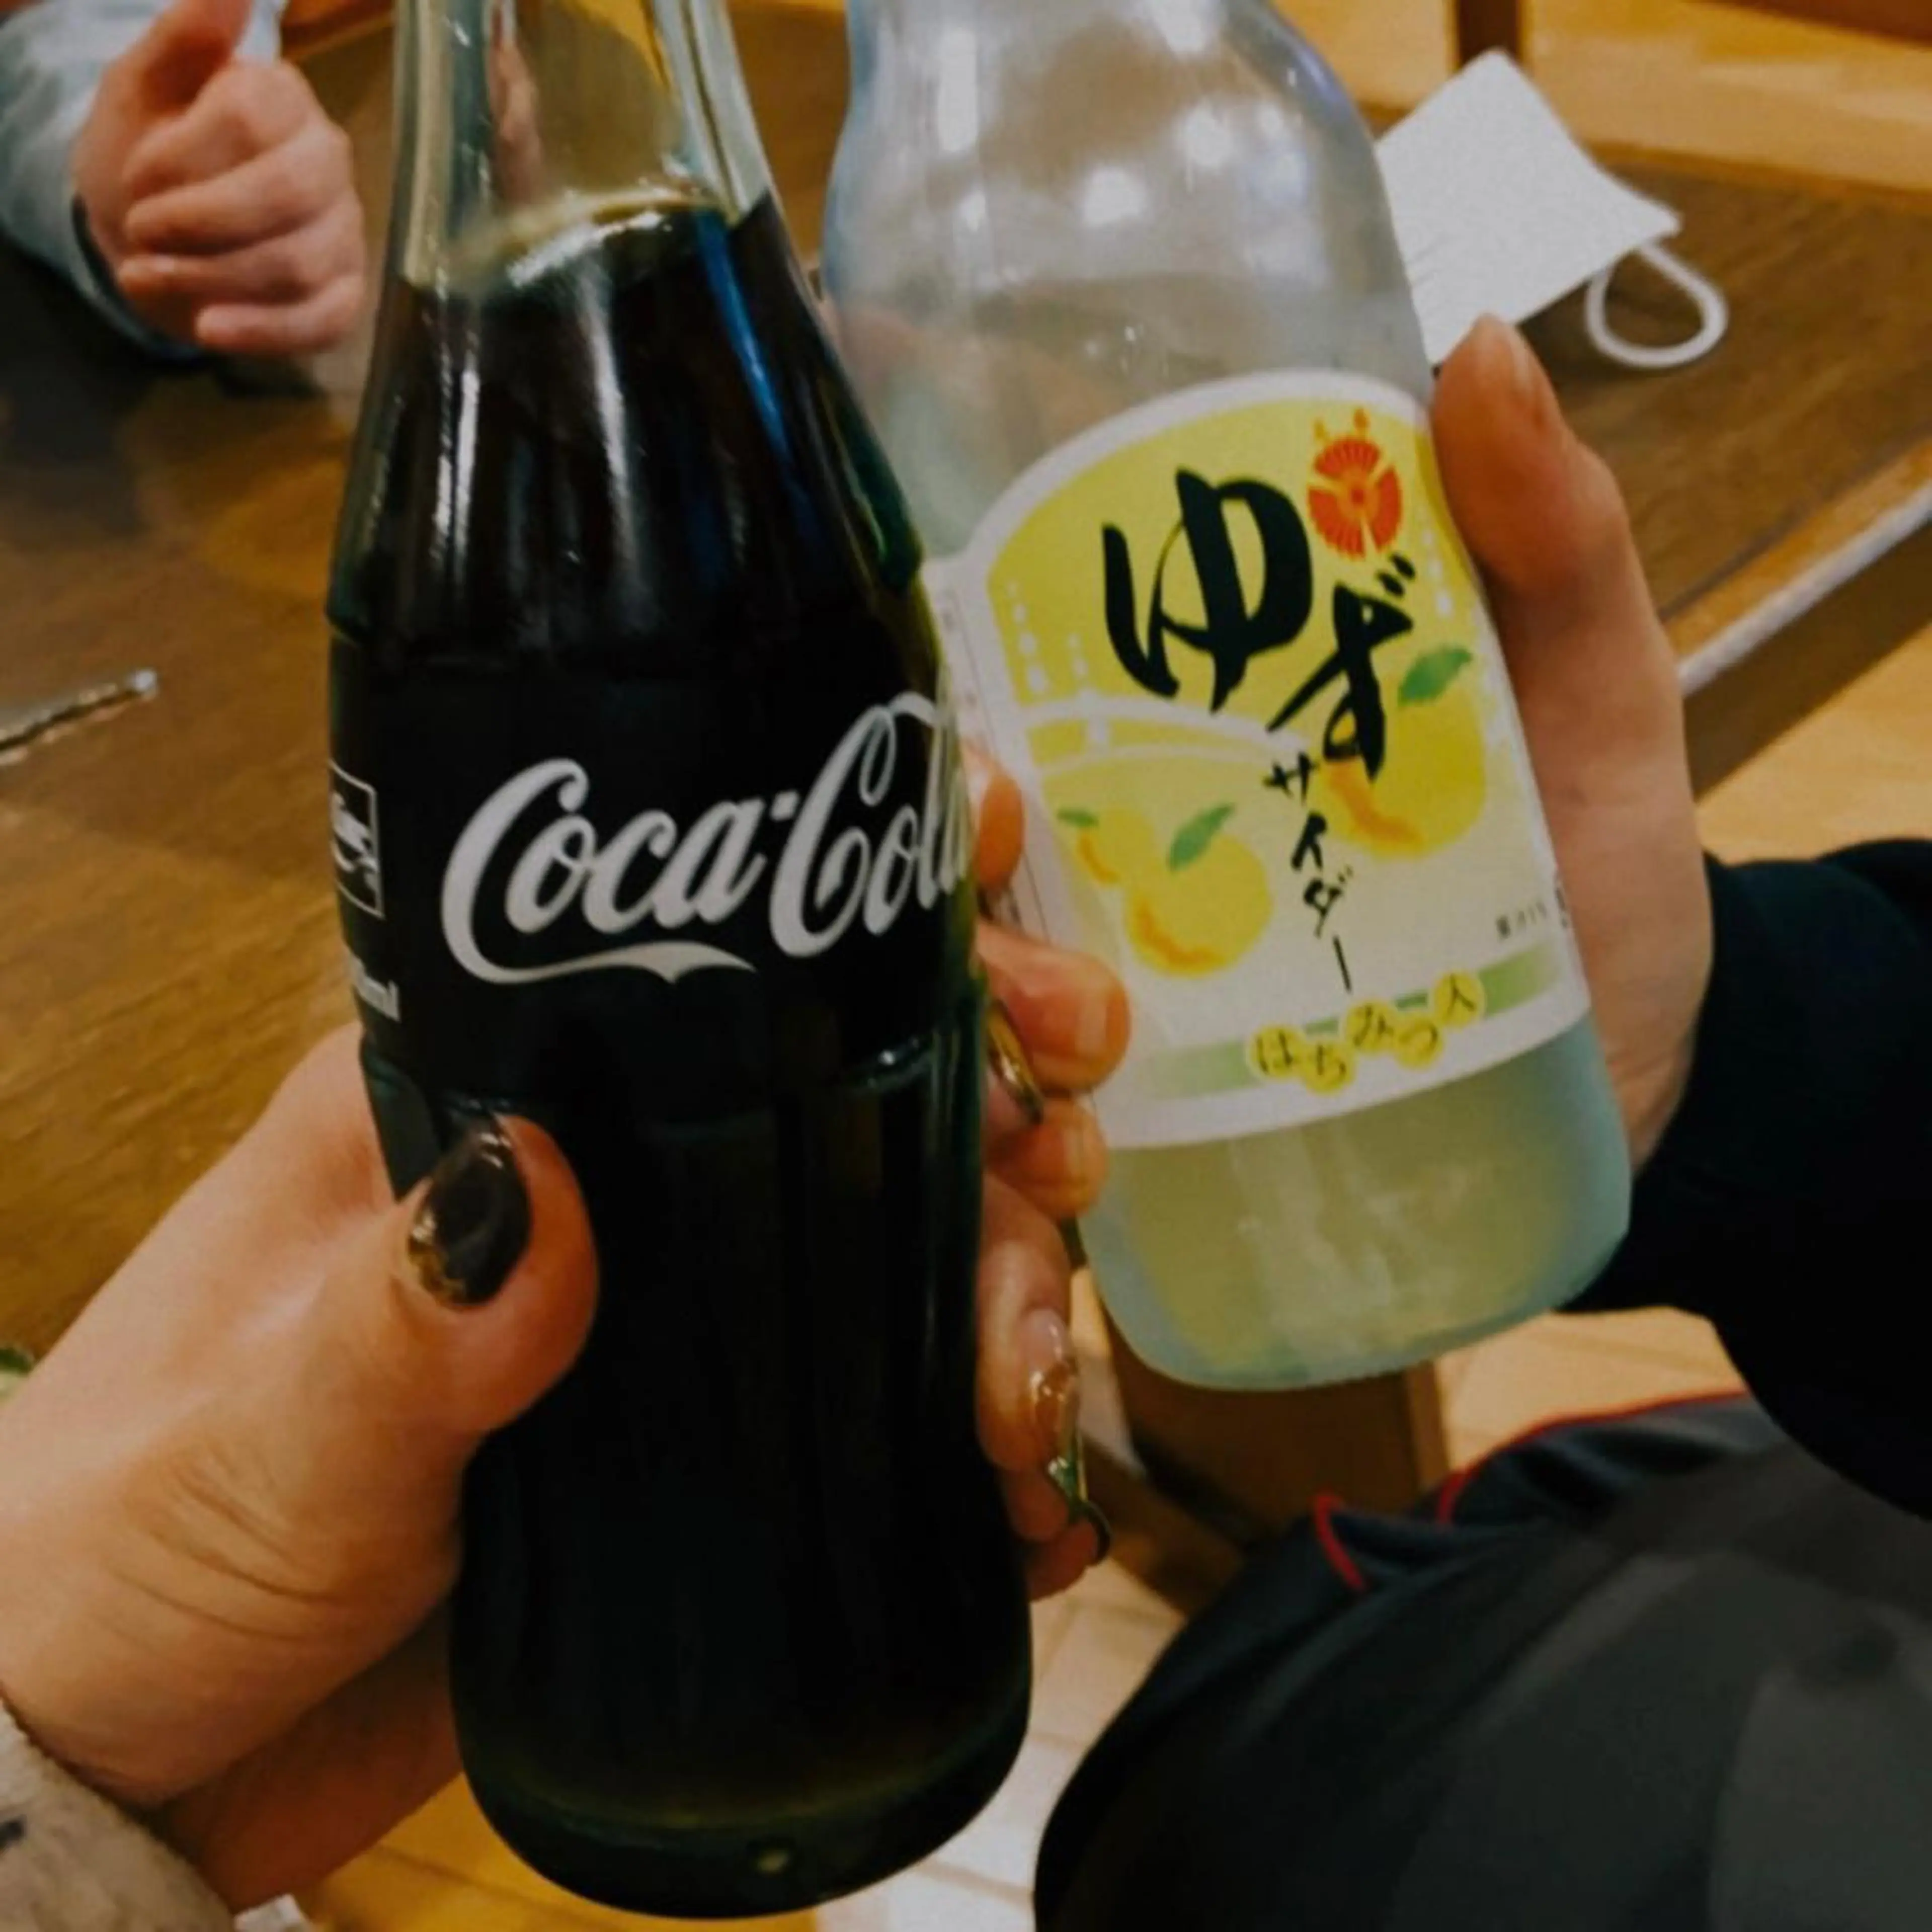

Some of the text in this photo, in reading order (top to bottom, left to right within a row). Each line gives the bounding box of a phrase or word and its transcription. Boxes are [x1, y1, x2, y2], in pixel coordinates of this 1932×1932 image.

[1101, 467, 1416, 781] ゆず
[1262, 751, 1354, 993] サイダー
